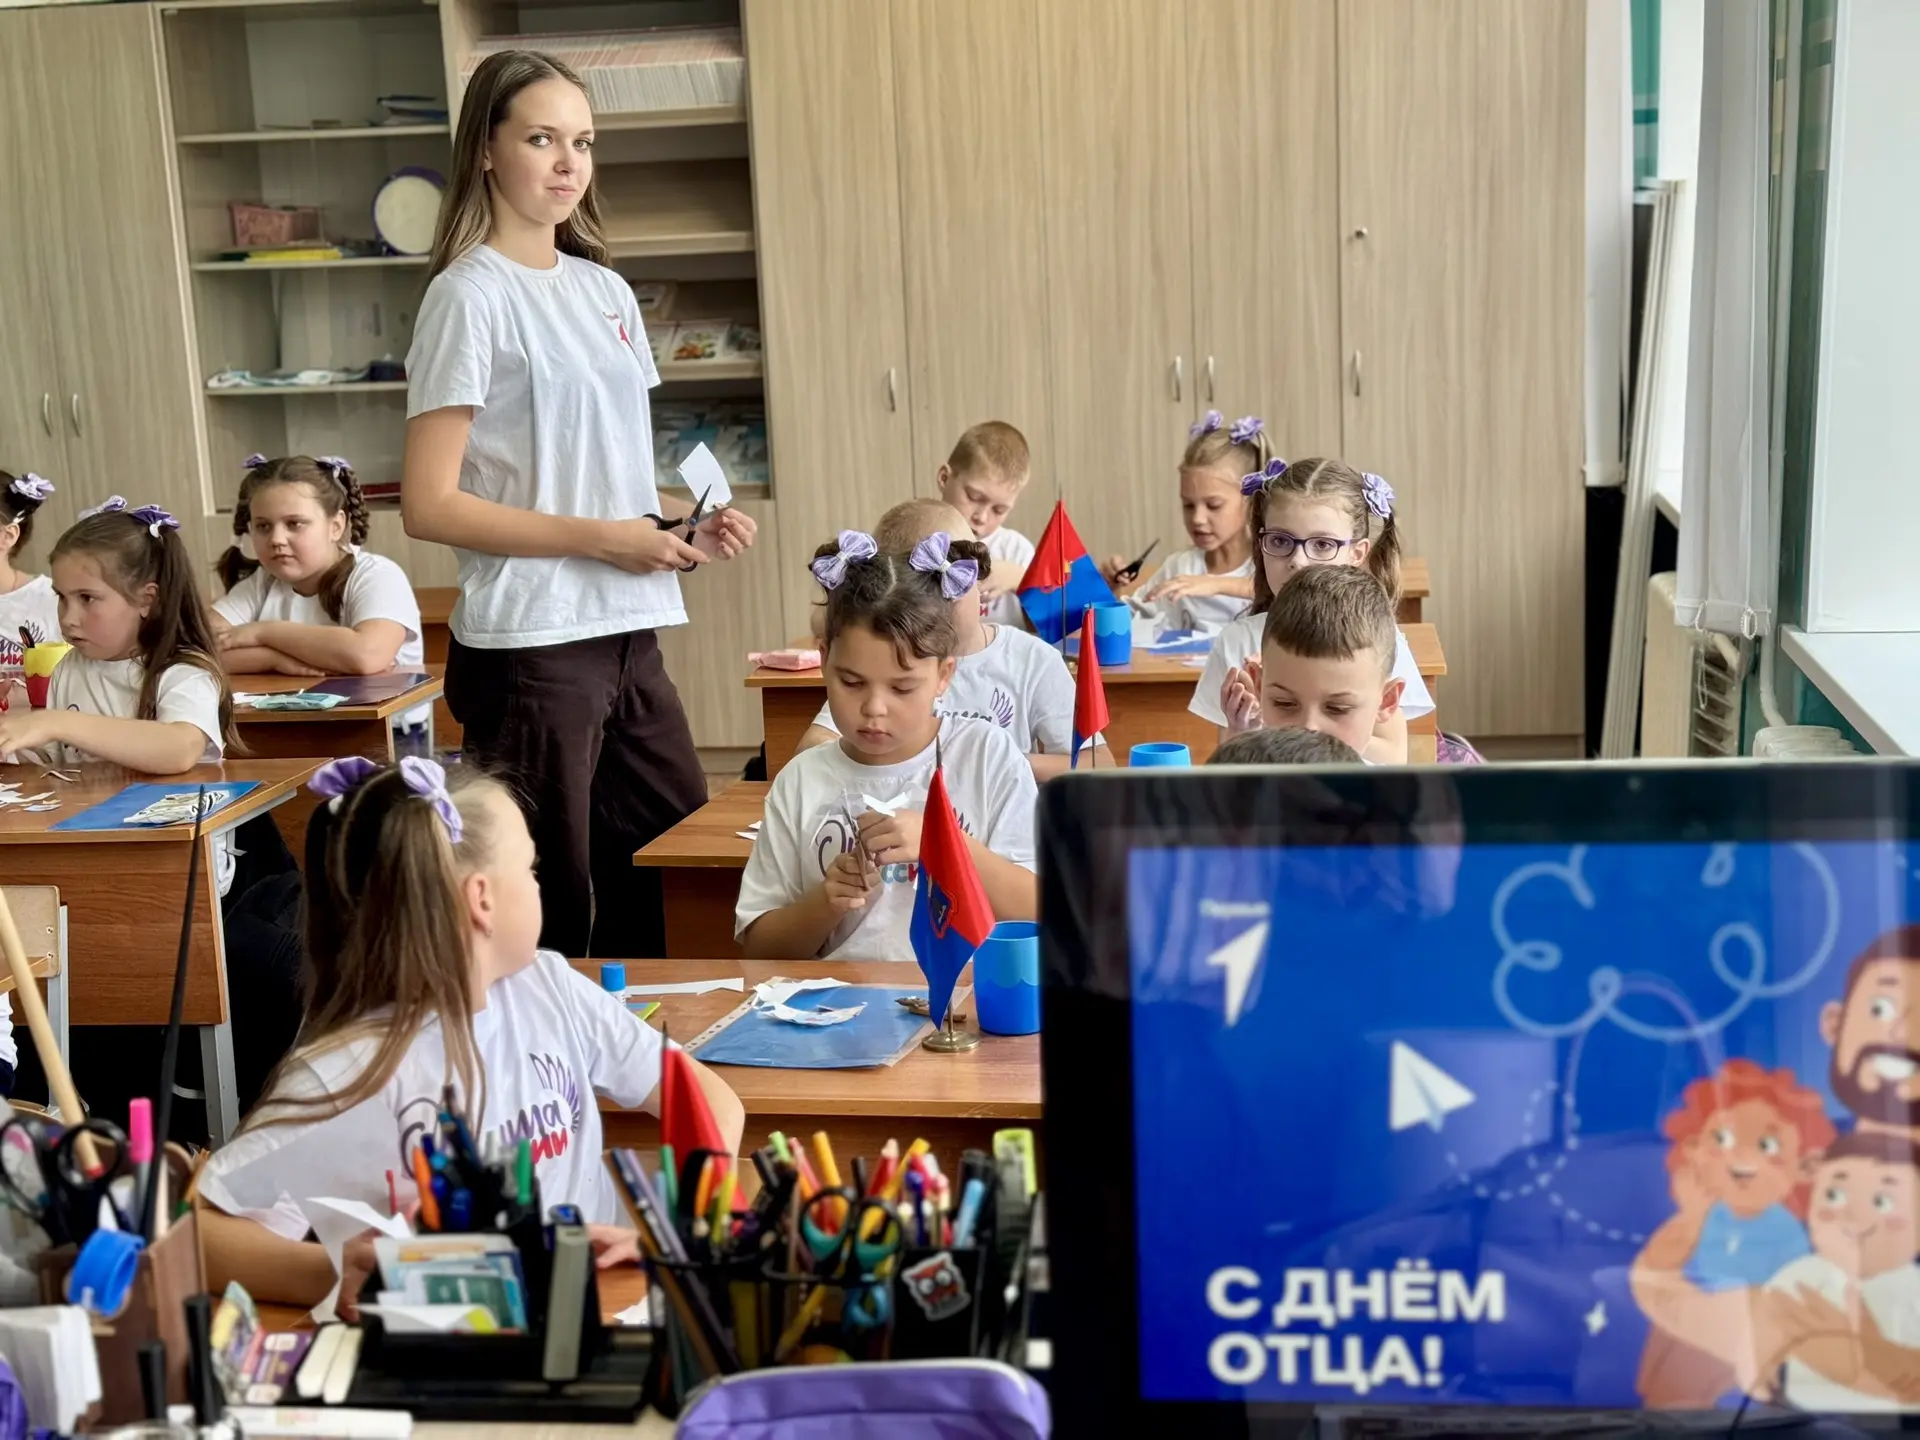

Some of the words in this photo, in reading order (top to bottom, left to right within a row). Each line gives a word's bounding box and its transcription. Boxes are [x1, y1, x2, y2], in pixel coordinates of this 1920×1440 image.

[1205, 1265, 1262, 1320] С
[1272, 1257, 1506, 1329] ДНЁМ
[1206, 1331, 1444, 1395] ОТЦА!
